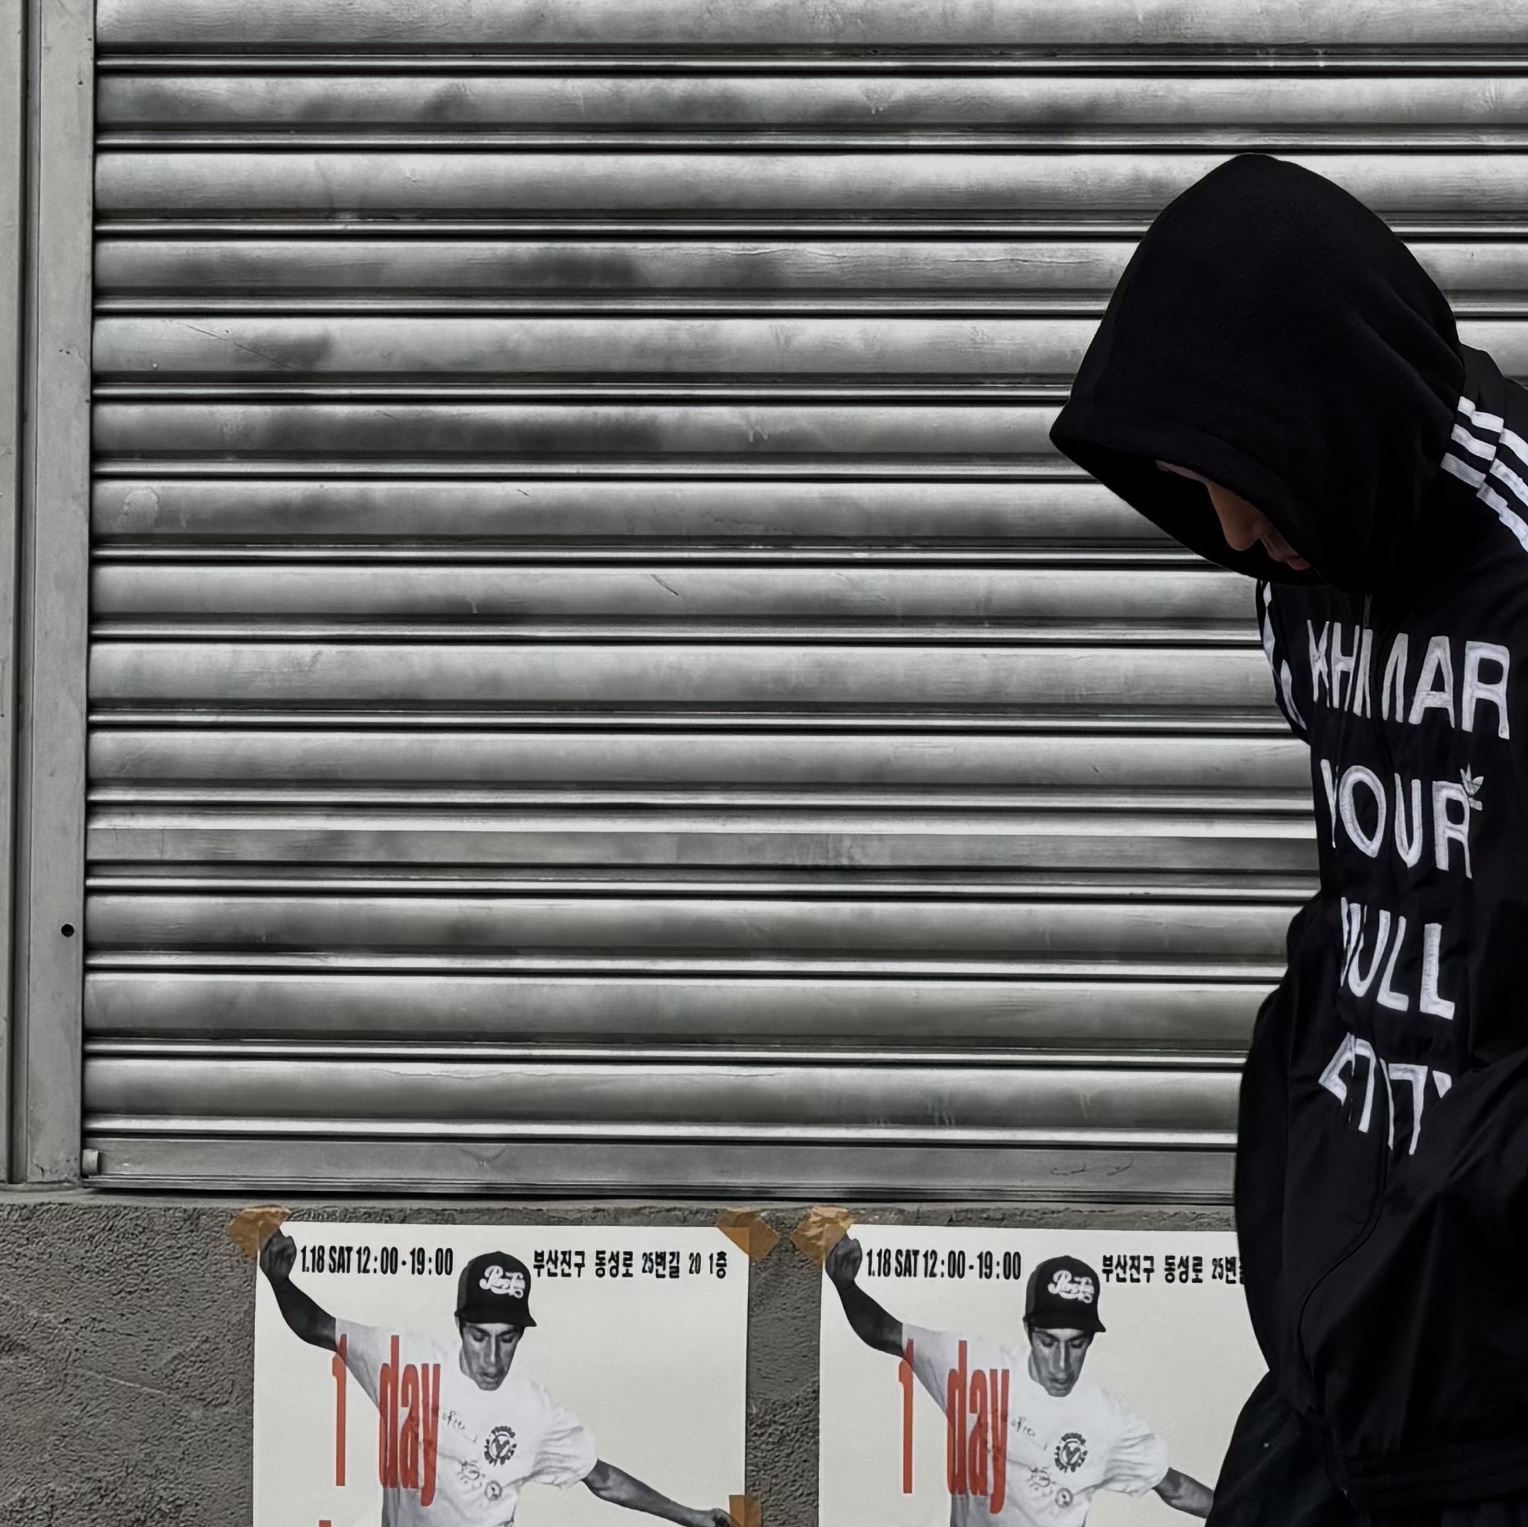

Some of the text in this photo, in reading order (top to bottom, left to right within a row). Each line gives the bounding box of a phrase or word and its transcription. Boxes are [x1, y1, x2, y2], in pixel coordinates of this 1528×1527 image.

[301, 1245, 325, 1273] 1.18
[329, 1246, 353, 1273] SAT
[533, 1249, 586, 1278] 부산진구
[595, 1250, 634, 1278] 동성로
[688, 1252, 702, 1275] 20
[709, 1251, 728, 1279] 1층
[866, 1248, 891, 1277] 1.18
[895, 1249, 920, 1277] SAT
[1102, 1254, 1155, 1283] 부산진구
[1164, 1255, 1203, 1284] 동성로
[379, 1335, 441, 1507] day
[947, 1340, 1009, 1514] day
